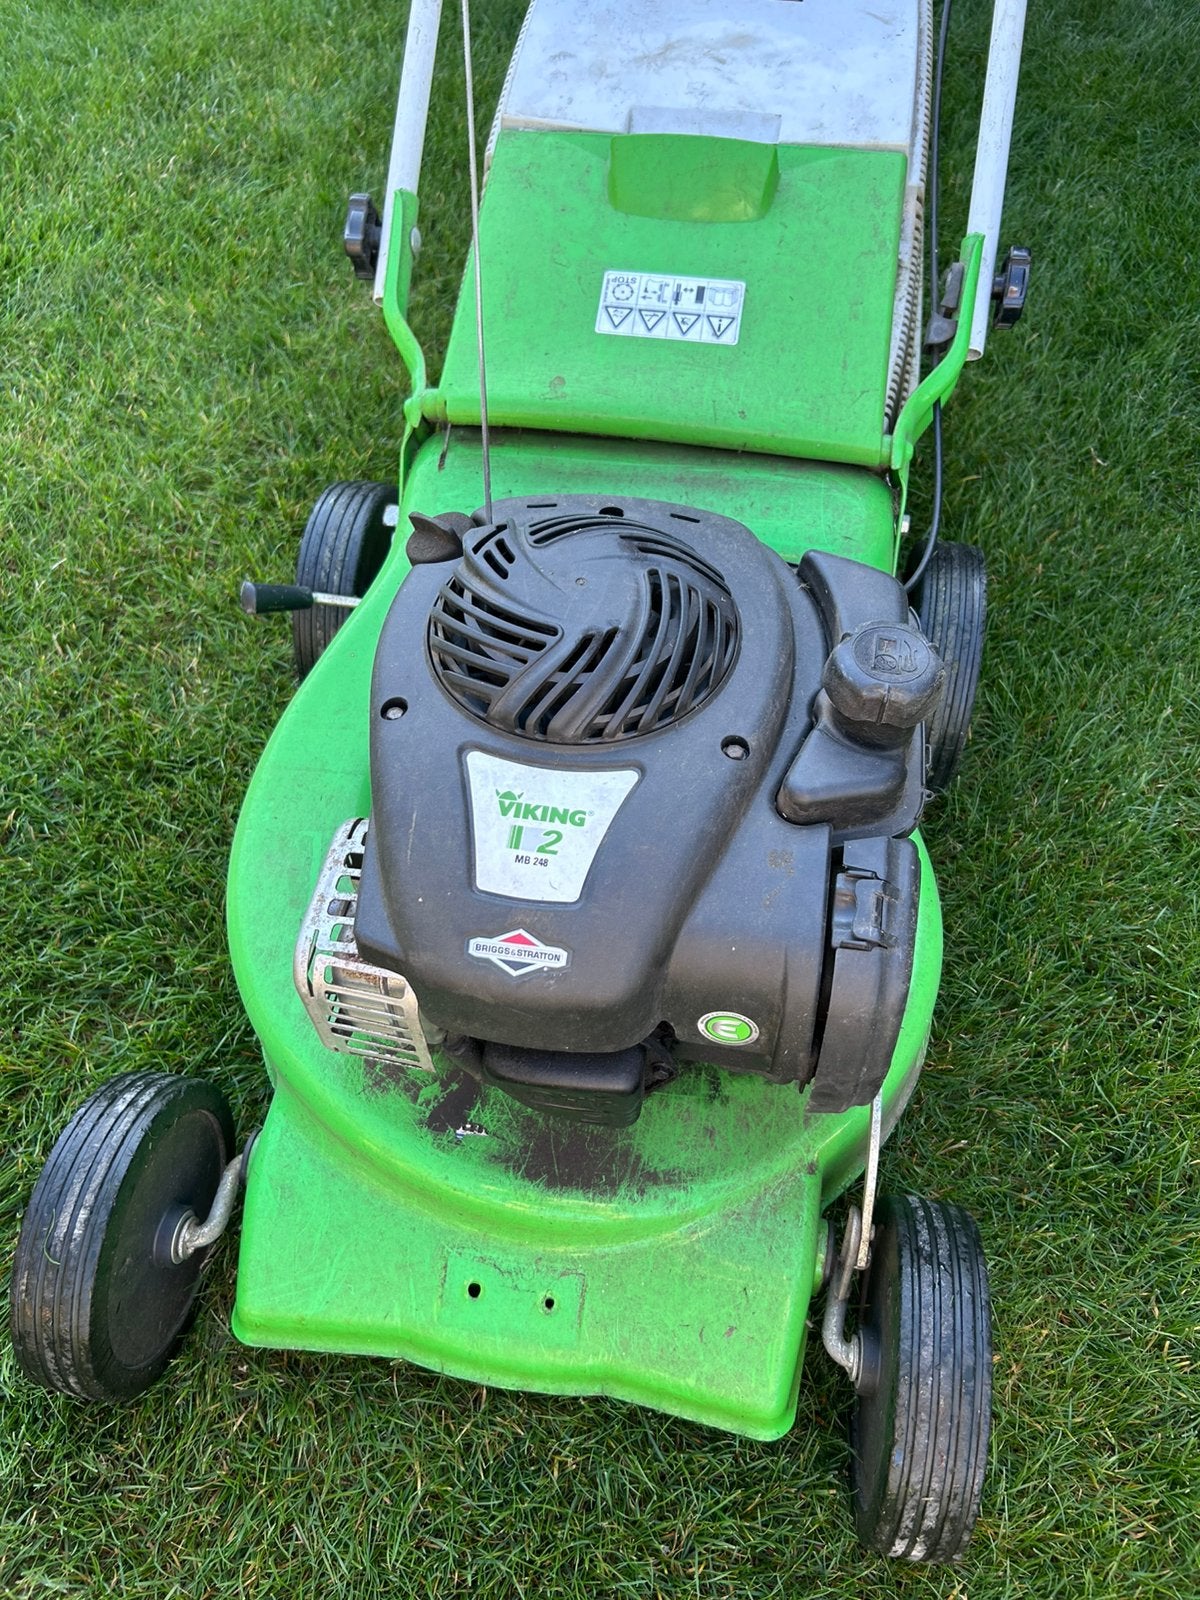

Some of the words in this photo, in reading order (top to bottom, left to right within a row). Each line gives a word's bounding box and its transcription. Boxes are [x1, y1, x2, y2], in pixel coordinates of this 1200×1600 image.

[611, 275, 637, 284] STOP
[514, 854, 531, 865] MB
[533, 857, 549, 868] 248
[475, 943, 561, 962] BRIGGS&STRATTON
